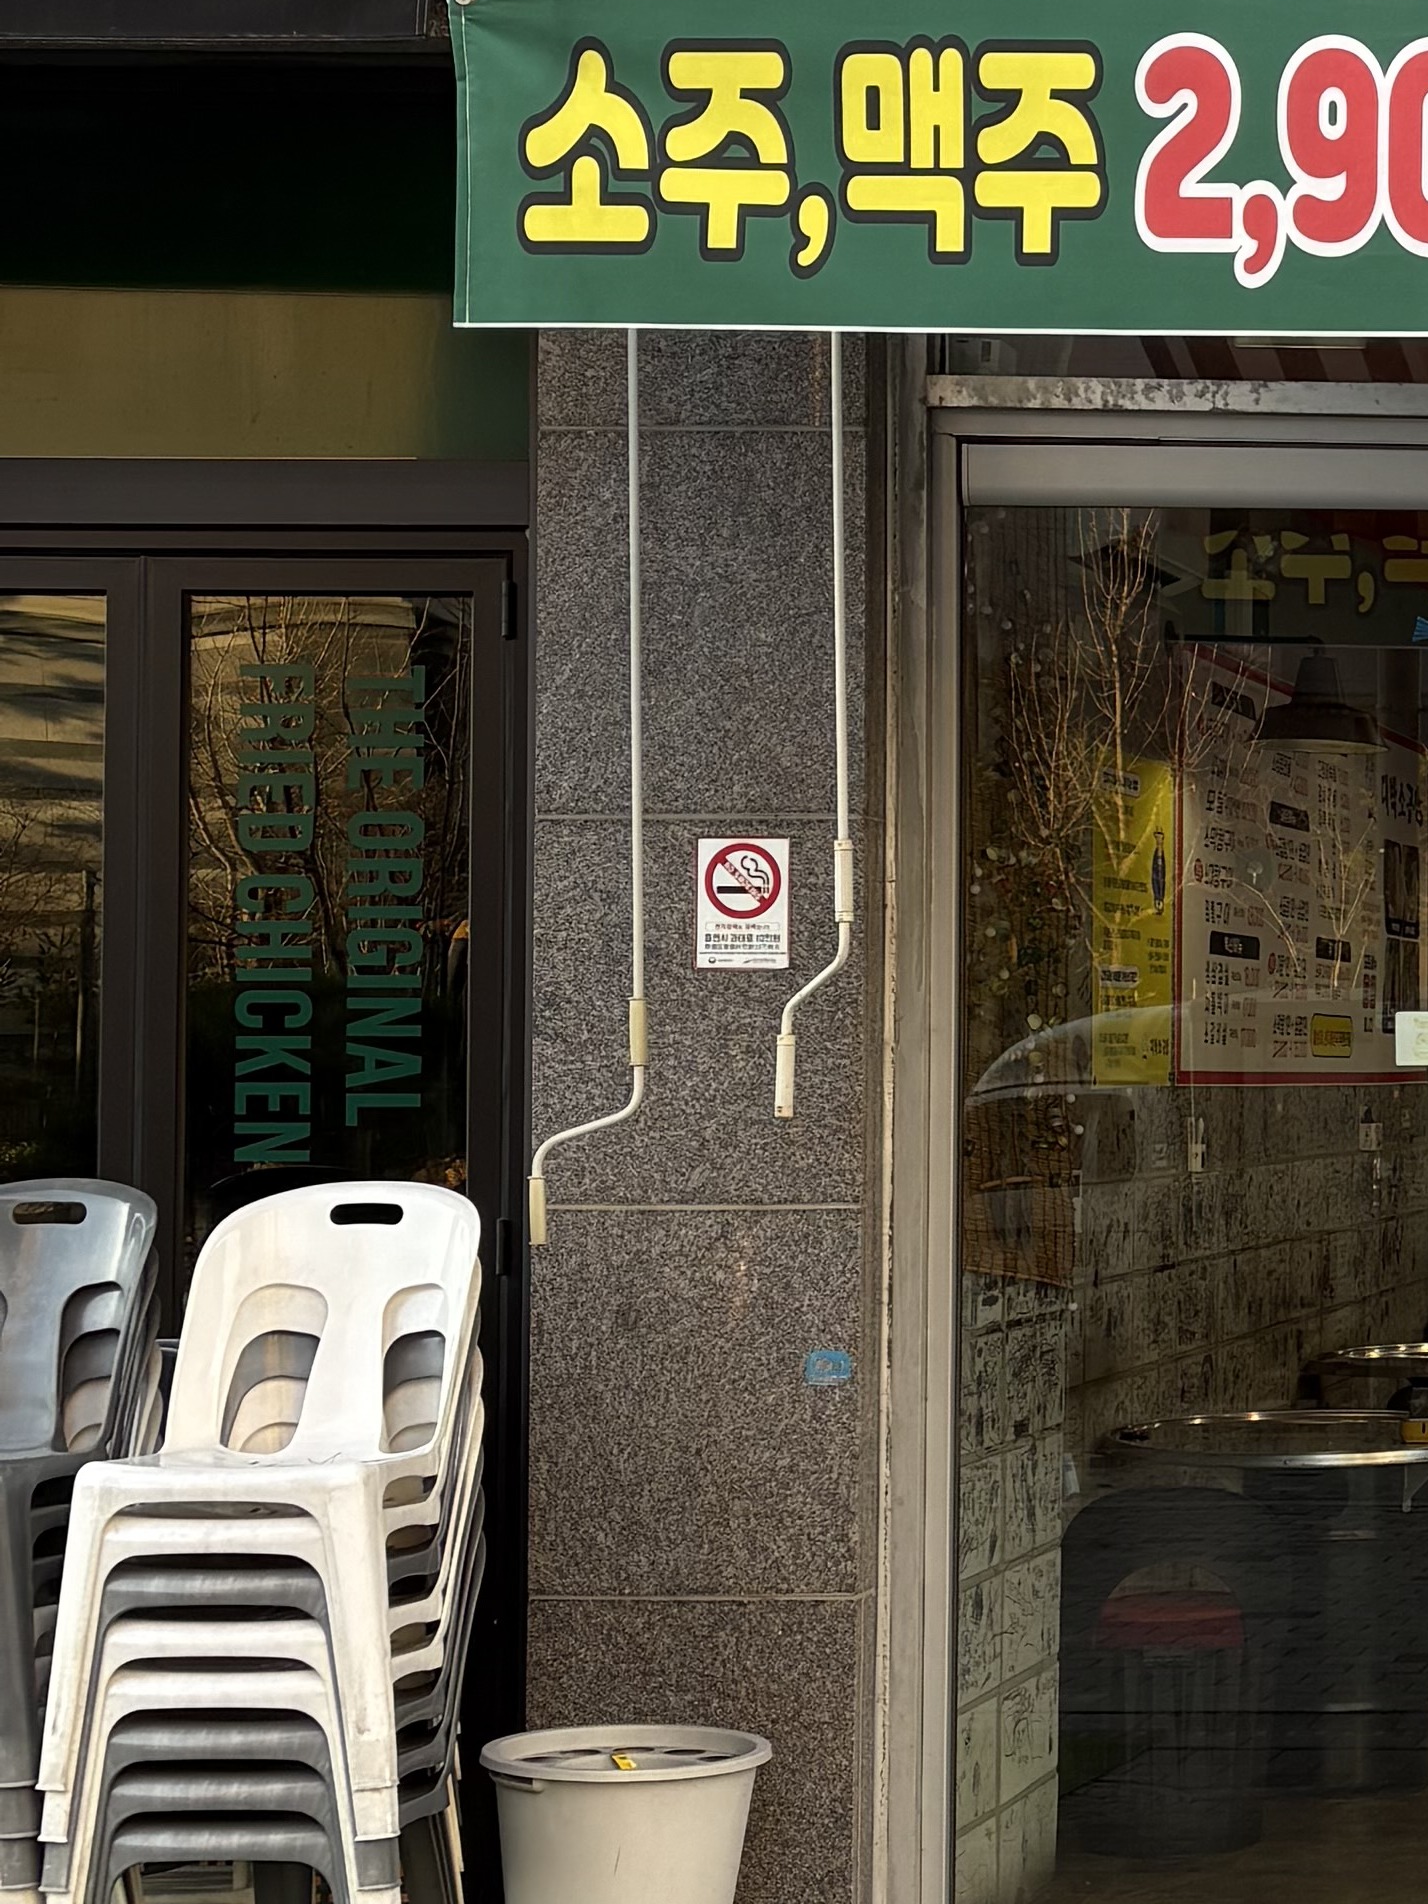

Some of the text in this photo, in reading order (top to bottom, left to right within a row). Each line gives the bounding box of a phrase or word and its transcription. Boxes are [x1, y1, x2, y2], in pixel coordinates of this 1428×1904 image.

[519, 35, 1107, 276] 소주,맥주
[233, 663, 316, 1163] FRIED CHICKEN
[344, 664, 425, 1127] THE ORIGINAL
